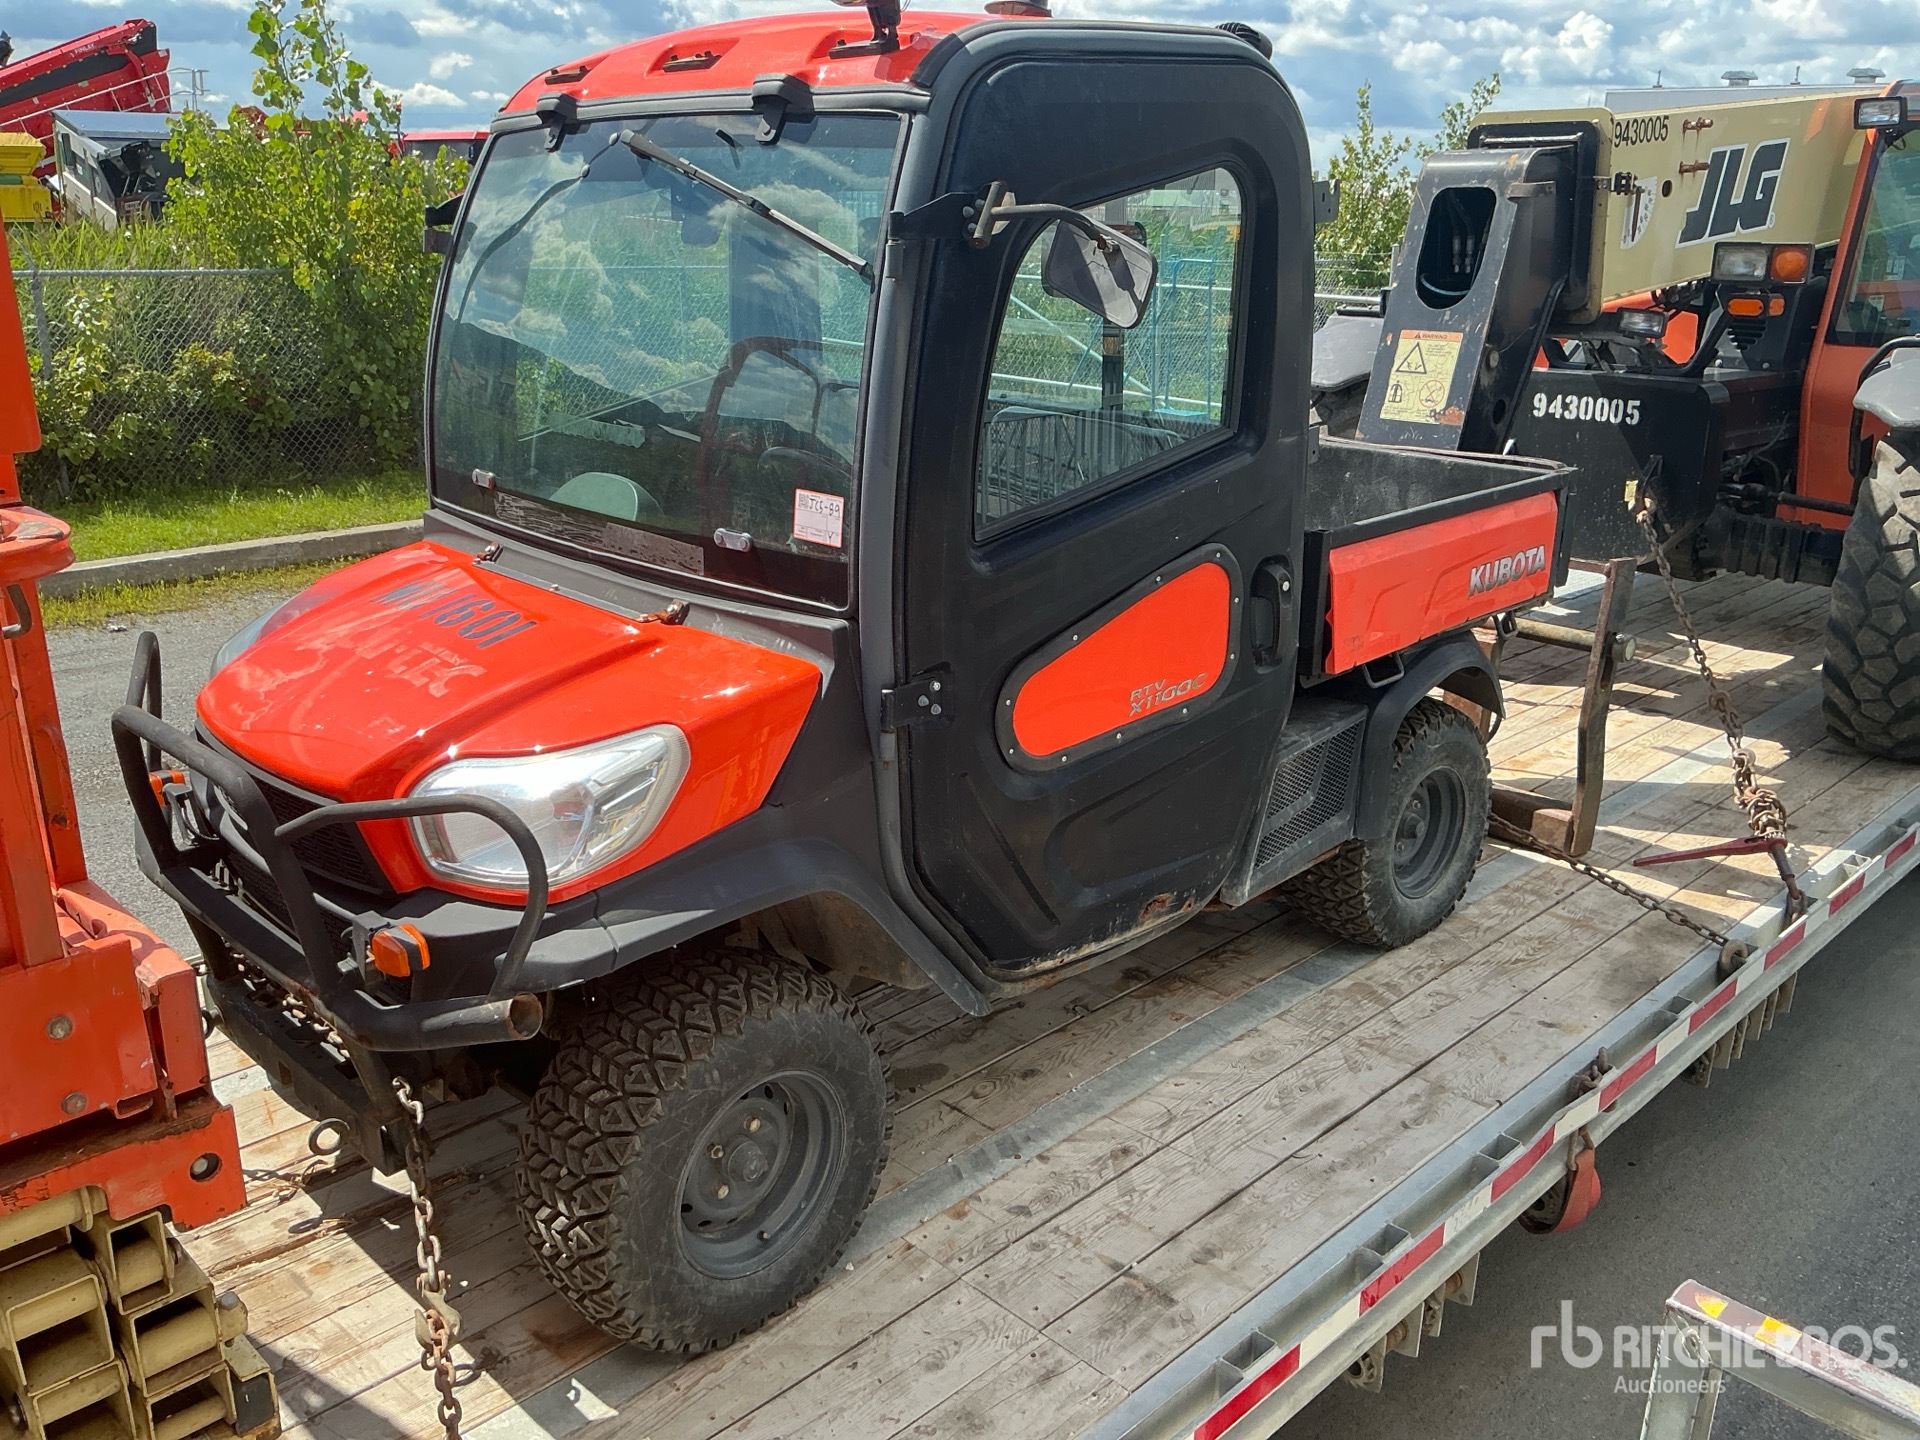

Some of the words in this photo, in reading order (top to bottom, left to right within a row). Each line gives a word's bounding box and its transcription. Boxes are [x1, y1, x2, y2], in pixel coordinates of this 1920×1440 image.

[1614, 115, 1669, 148] 9430005
[1676, 138, 1790, 247] JLG
[1422, 332, 1448, 340] WARNING
[1532, 392, 1641, 425] 9430005
[1468, 545, 1545, 597] KUBOTA
[1130, 679, 1167, 701] RTV
